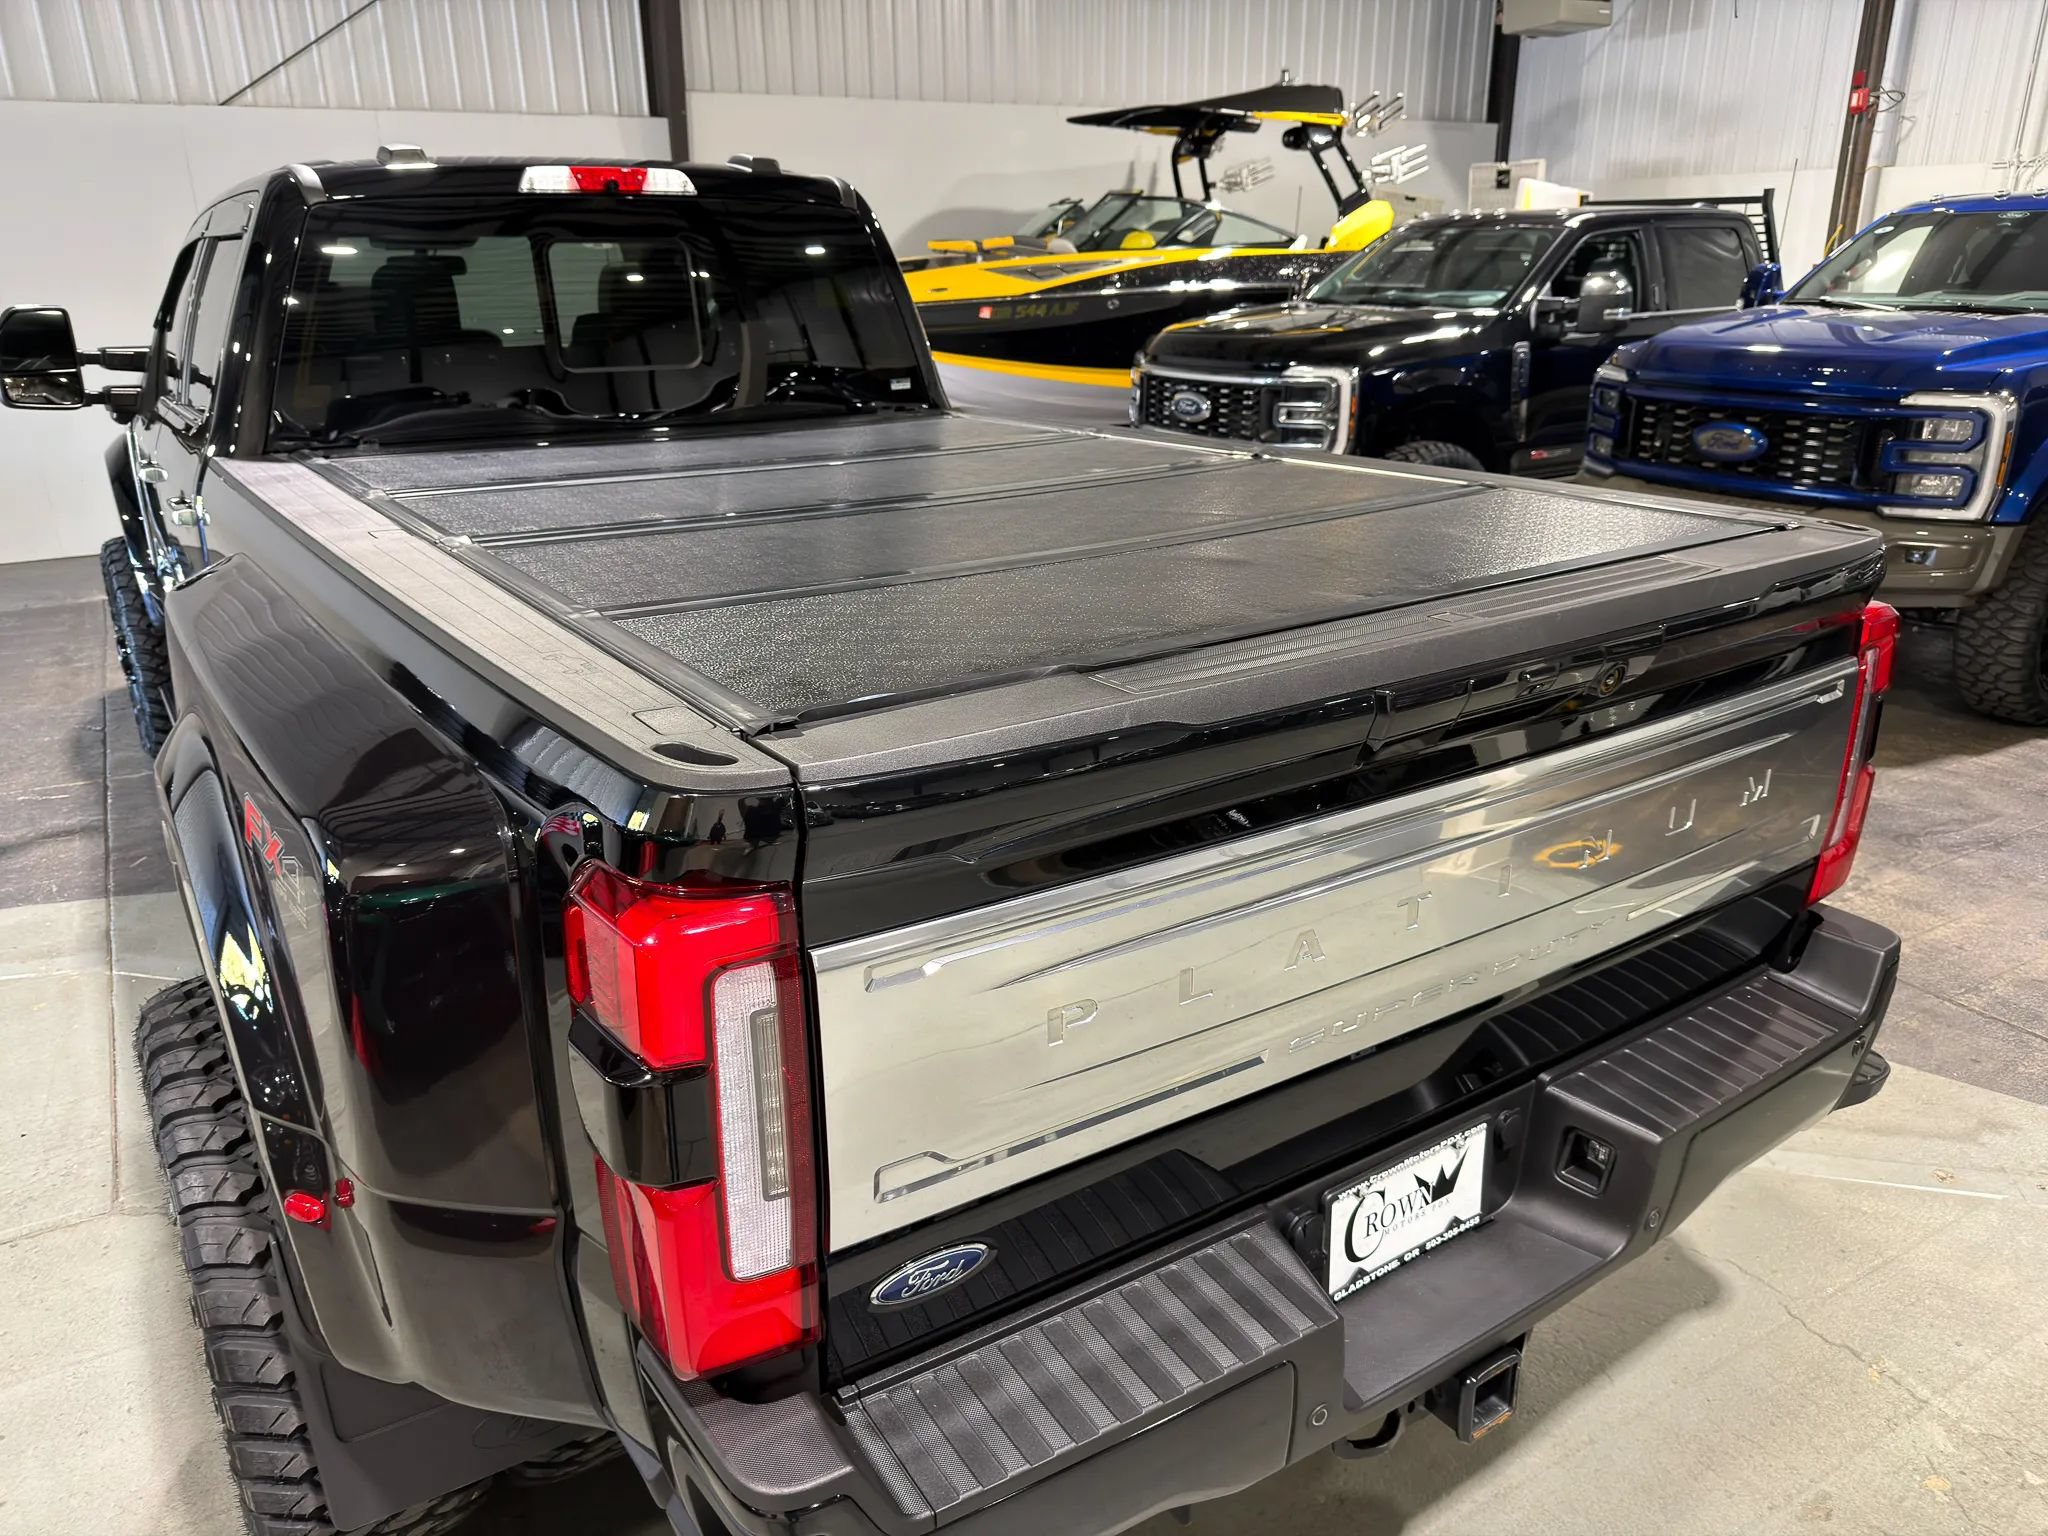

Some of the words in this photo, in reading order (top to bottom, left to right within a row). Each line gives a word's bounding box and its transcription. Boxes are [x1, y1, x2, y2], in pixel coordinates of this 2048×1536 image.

[1047, 767, 1772, 1047] PLATINUM
[1288, 970, 1480, 1054] SUPER
[1337, 1122, 1488, 1200] www.CrownMotorsPDX.com
[1344, 1181, 1434, 1263] CROWN
[1384, 1210, 1427, 1235] MOTORS
[1403, 1247, 1421, 1263] OR
[901, 1259, 965, 1298] Ford
